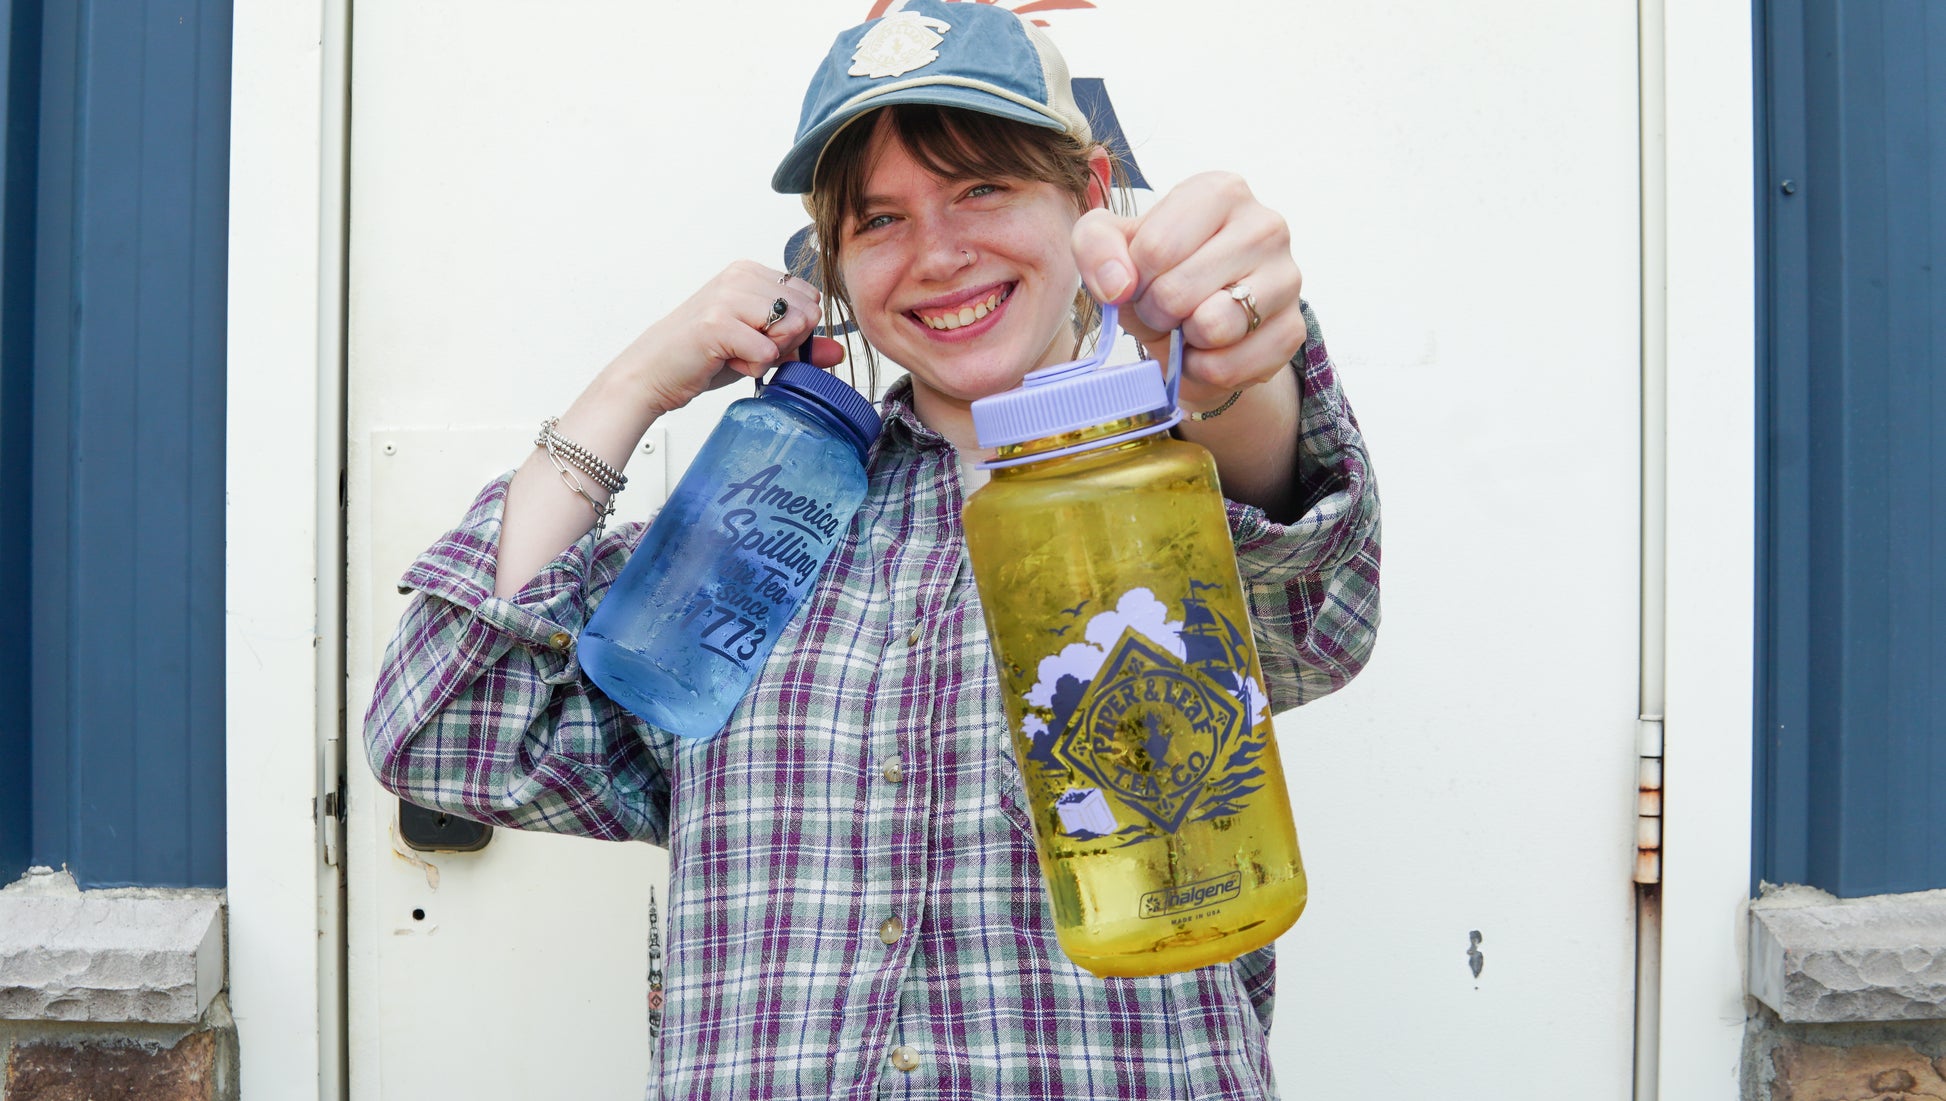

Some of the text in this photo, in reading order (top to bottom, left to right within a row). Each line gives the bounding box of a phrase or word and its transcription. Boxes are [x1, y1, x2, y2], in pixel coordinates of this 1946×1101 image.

[717, 464, 839, 545] America,
[711, 508, 818, 587] Spilling
[753, 565, 789, 604] Tea
[679, 600, 767, 660] 1773
[1092, 684, 1141, 754] PIPER
[1144, 678, 1160, 702] &
[1114, 765, 1162, 795] TEA
[1168, 880, 1236, 906] nalgene
[1171, 916, 1192, 925] MADE
[1206, 909, 1221, 917] USA
